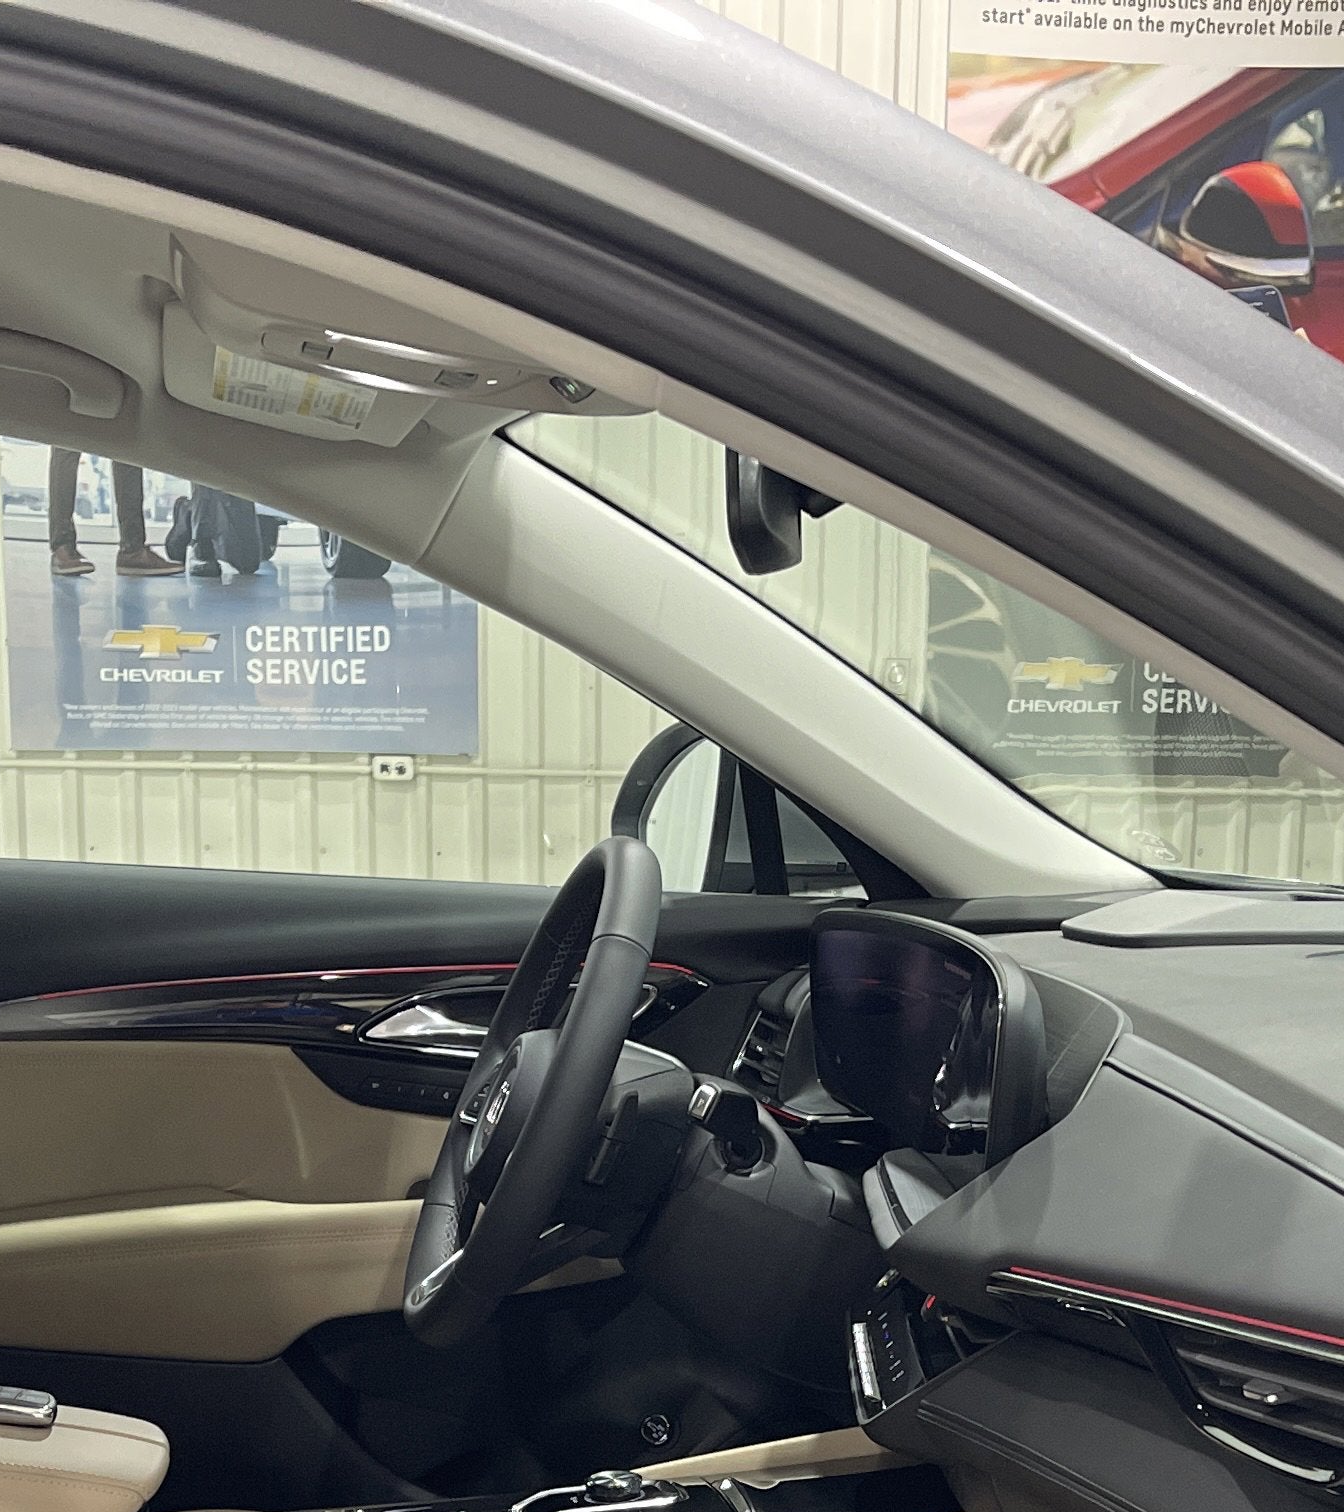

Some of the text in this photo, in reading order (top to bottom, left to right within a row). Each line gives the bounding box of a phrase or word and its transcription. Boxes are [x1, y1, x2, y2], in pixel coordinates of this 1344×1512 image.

[1213, 0, 1242, 11] and
[1248, 0, 1291, 16] enjoy
[1034, 12, 1107, 30] available
[1112, 18, 1133, 31] on
[1138, 15, 1165, 33] the
[1170, 18, 1276, 38] myChevrolet
[1280, 19, 1333, 36] Mobile
[244, 624, 392, 653] CERTIFIED
[99, 667, 225, 684] CHEVROLET
[244, 657, 369, 686] SERVICE
[1006, 698, 1123, 714] CHEVROLET
